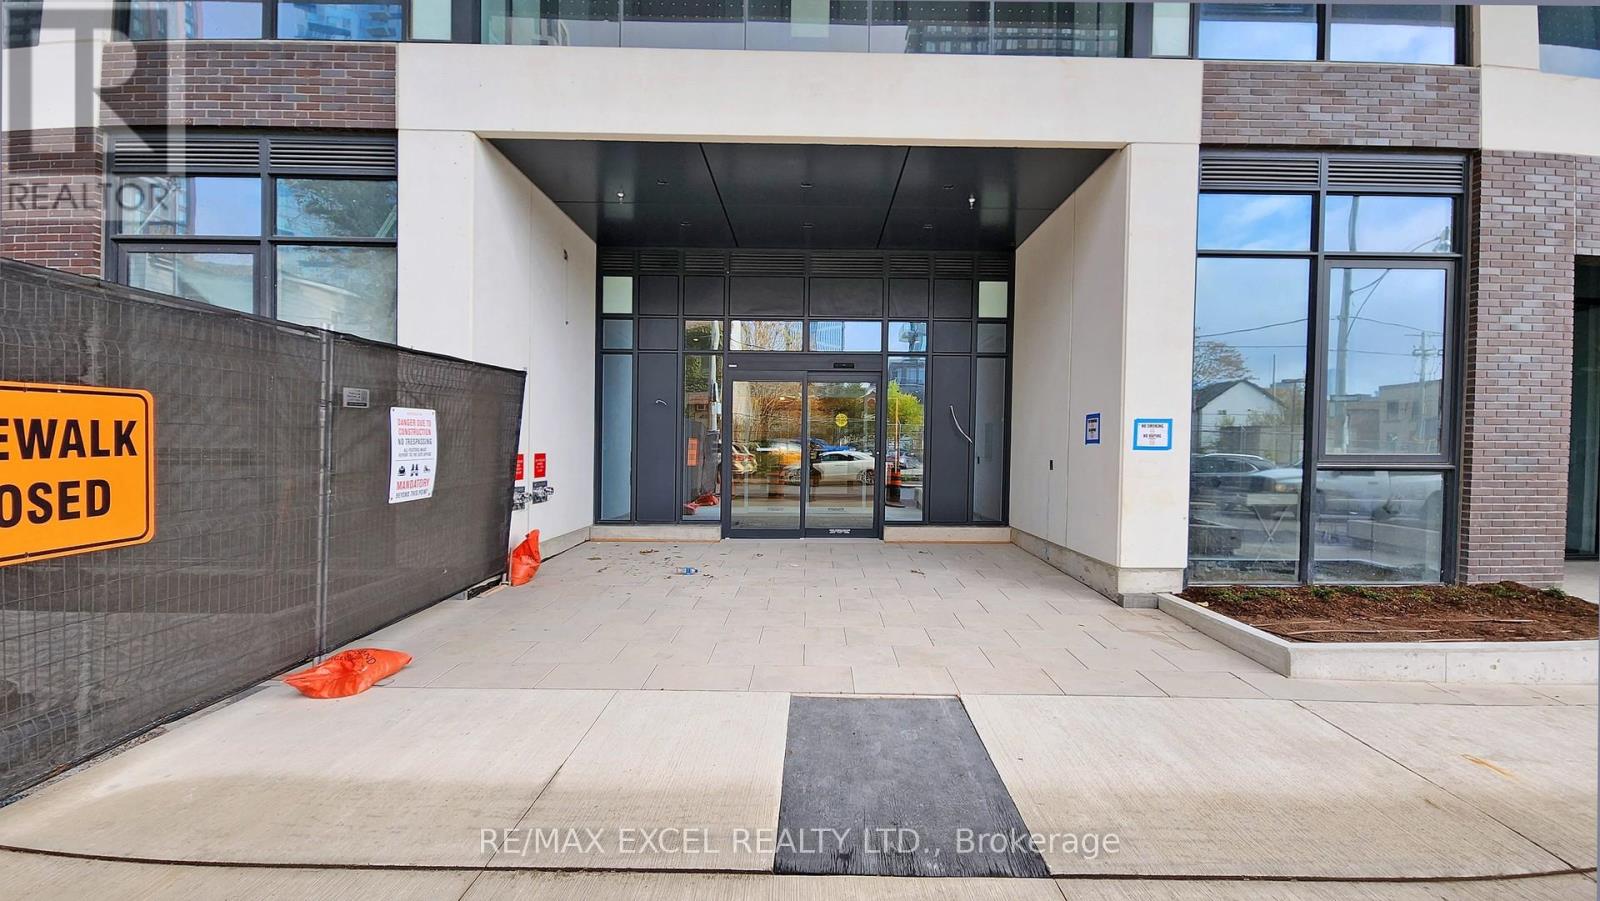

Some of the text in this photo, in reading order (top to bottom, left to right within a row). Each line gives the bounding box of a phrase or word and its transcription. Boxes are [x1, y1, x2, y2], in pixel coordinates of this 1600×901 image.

[398, 418, 416, 427] DANGER
[398, 427, 432, 436] CONSTRUCTION
[396, 478, 430, 490] MANDATORY
